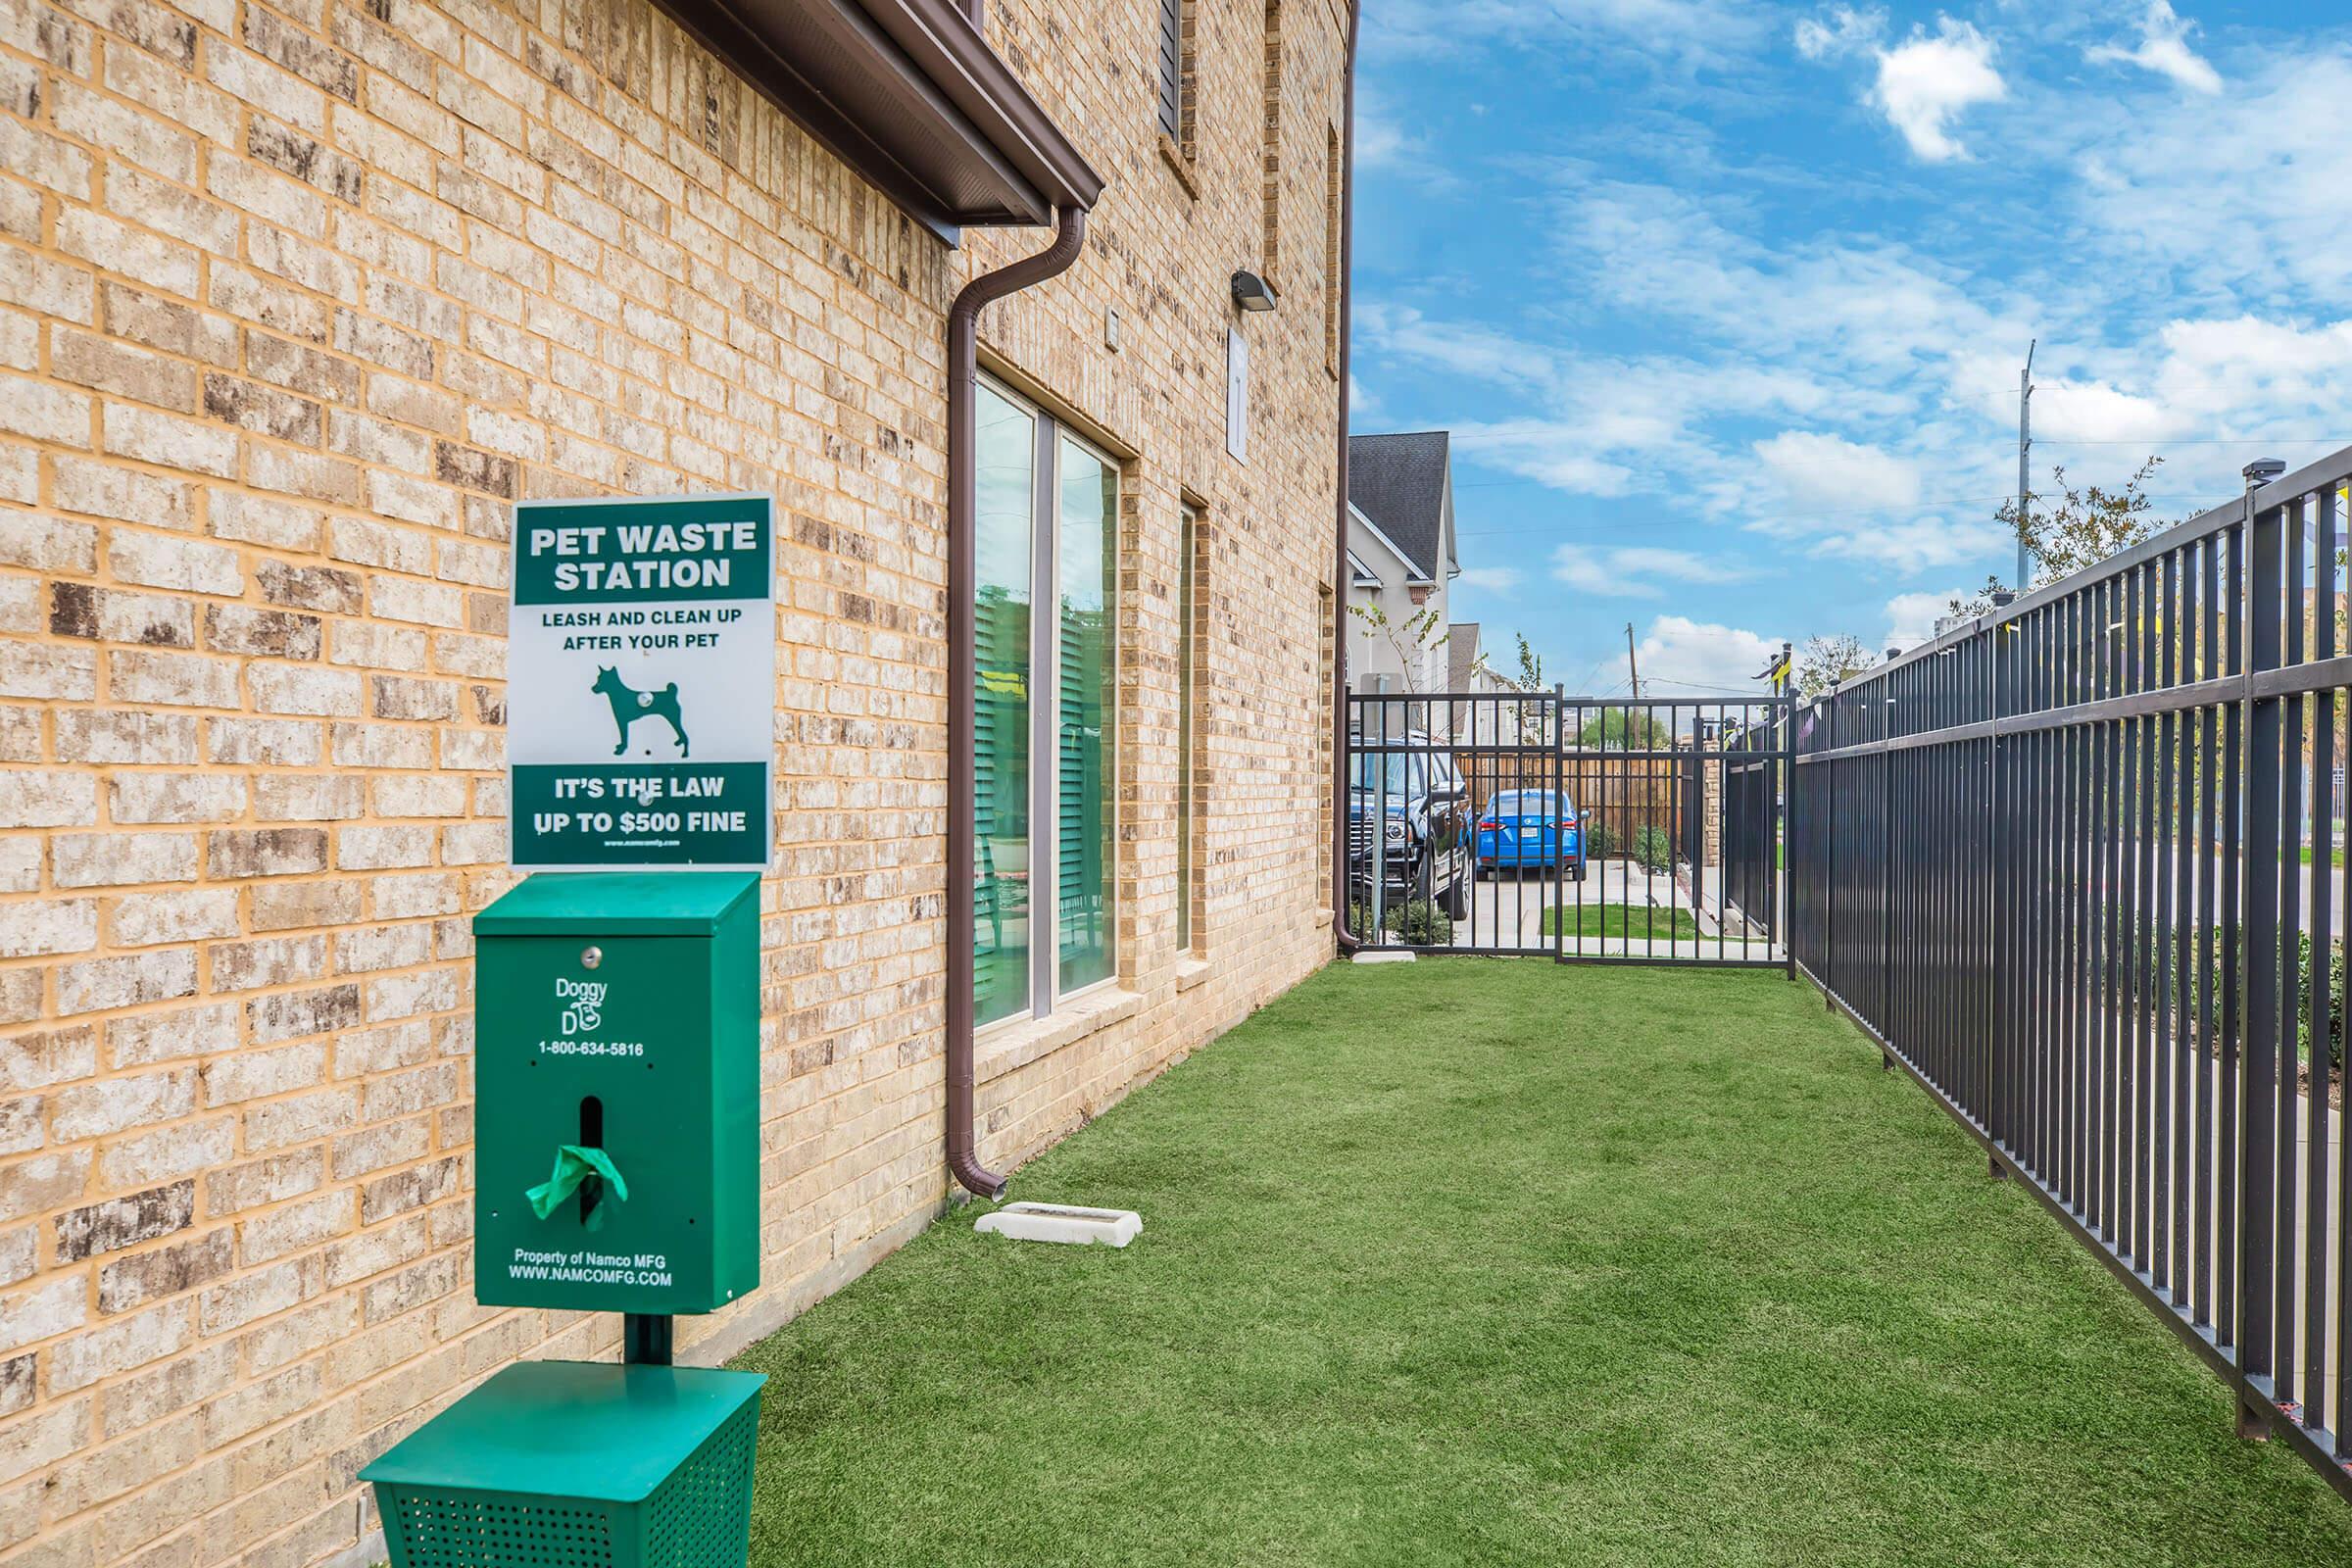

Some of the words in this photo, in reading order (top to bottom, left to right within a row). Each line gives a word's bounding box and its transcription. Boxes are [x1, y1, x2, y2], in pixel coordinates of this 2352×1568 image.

[530, 526, 606, 556] PET
[617, 521, 757, 553] WASTE
[554, 559, 730, 591] STATION
[543, 612, 601, 627] LEASH
[608, 612, 645, 626] AND
[651, 610, 711, 625] CLEAN
[717, 609, 742, 622] UP
[564, 636, 621, 651] AFTER
[628, 634, 679, 649] YOUR
[685, 633, 719, 648] PET
[555, 778, 605, 799] IT'S
[612, 778, 662, 798] THE
[670, 777, 724, 797] LAW
[534, 812, 569, 834] UP
[576, 812, 612, 833] TO
[619, 810, 680, 835] $500
[687, 811, 746, 832] FINE
[556, 978, 608, 1002] Doggy
[539, 1041, 643, 1056] 1-800-634-5816
[514, 1249, 566, 1266] Property
[570, 1251, 584, 1264] of
[587, 1251, 631, 1267] Namco
[634, 1254, 665, 1269] MFG
[509, 1265, 672, 1286] WWW.NAMCOMFG.COM
